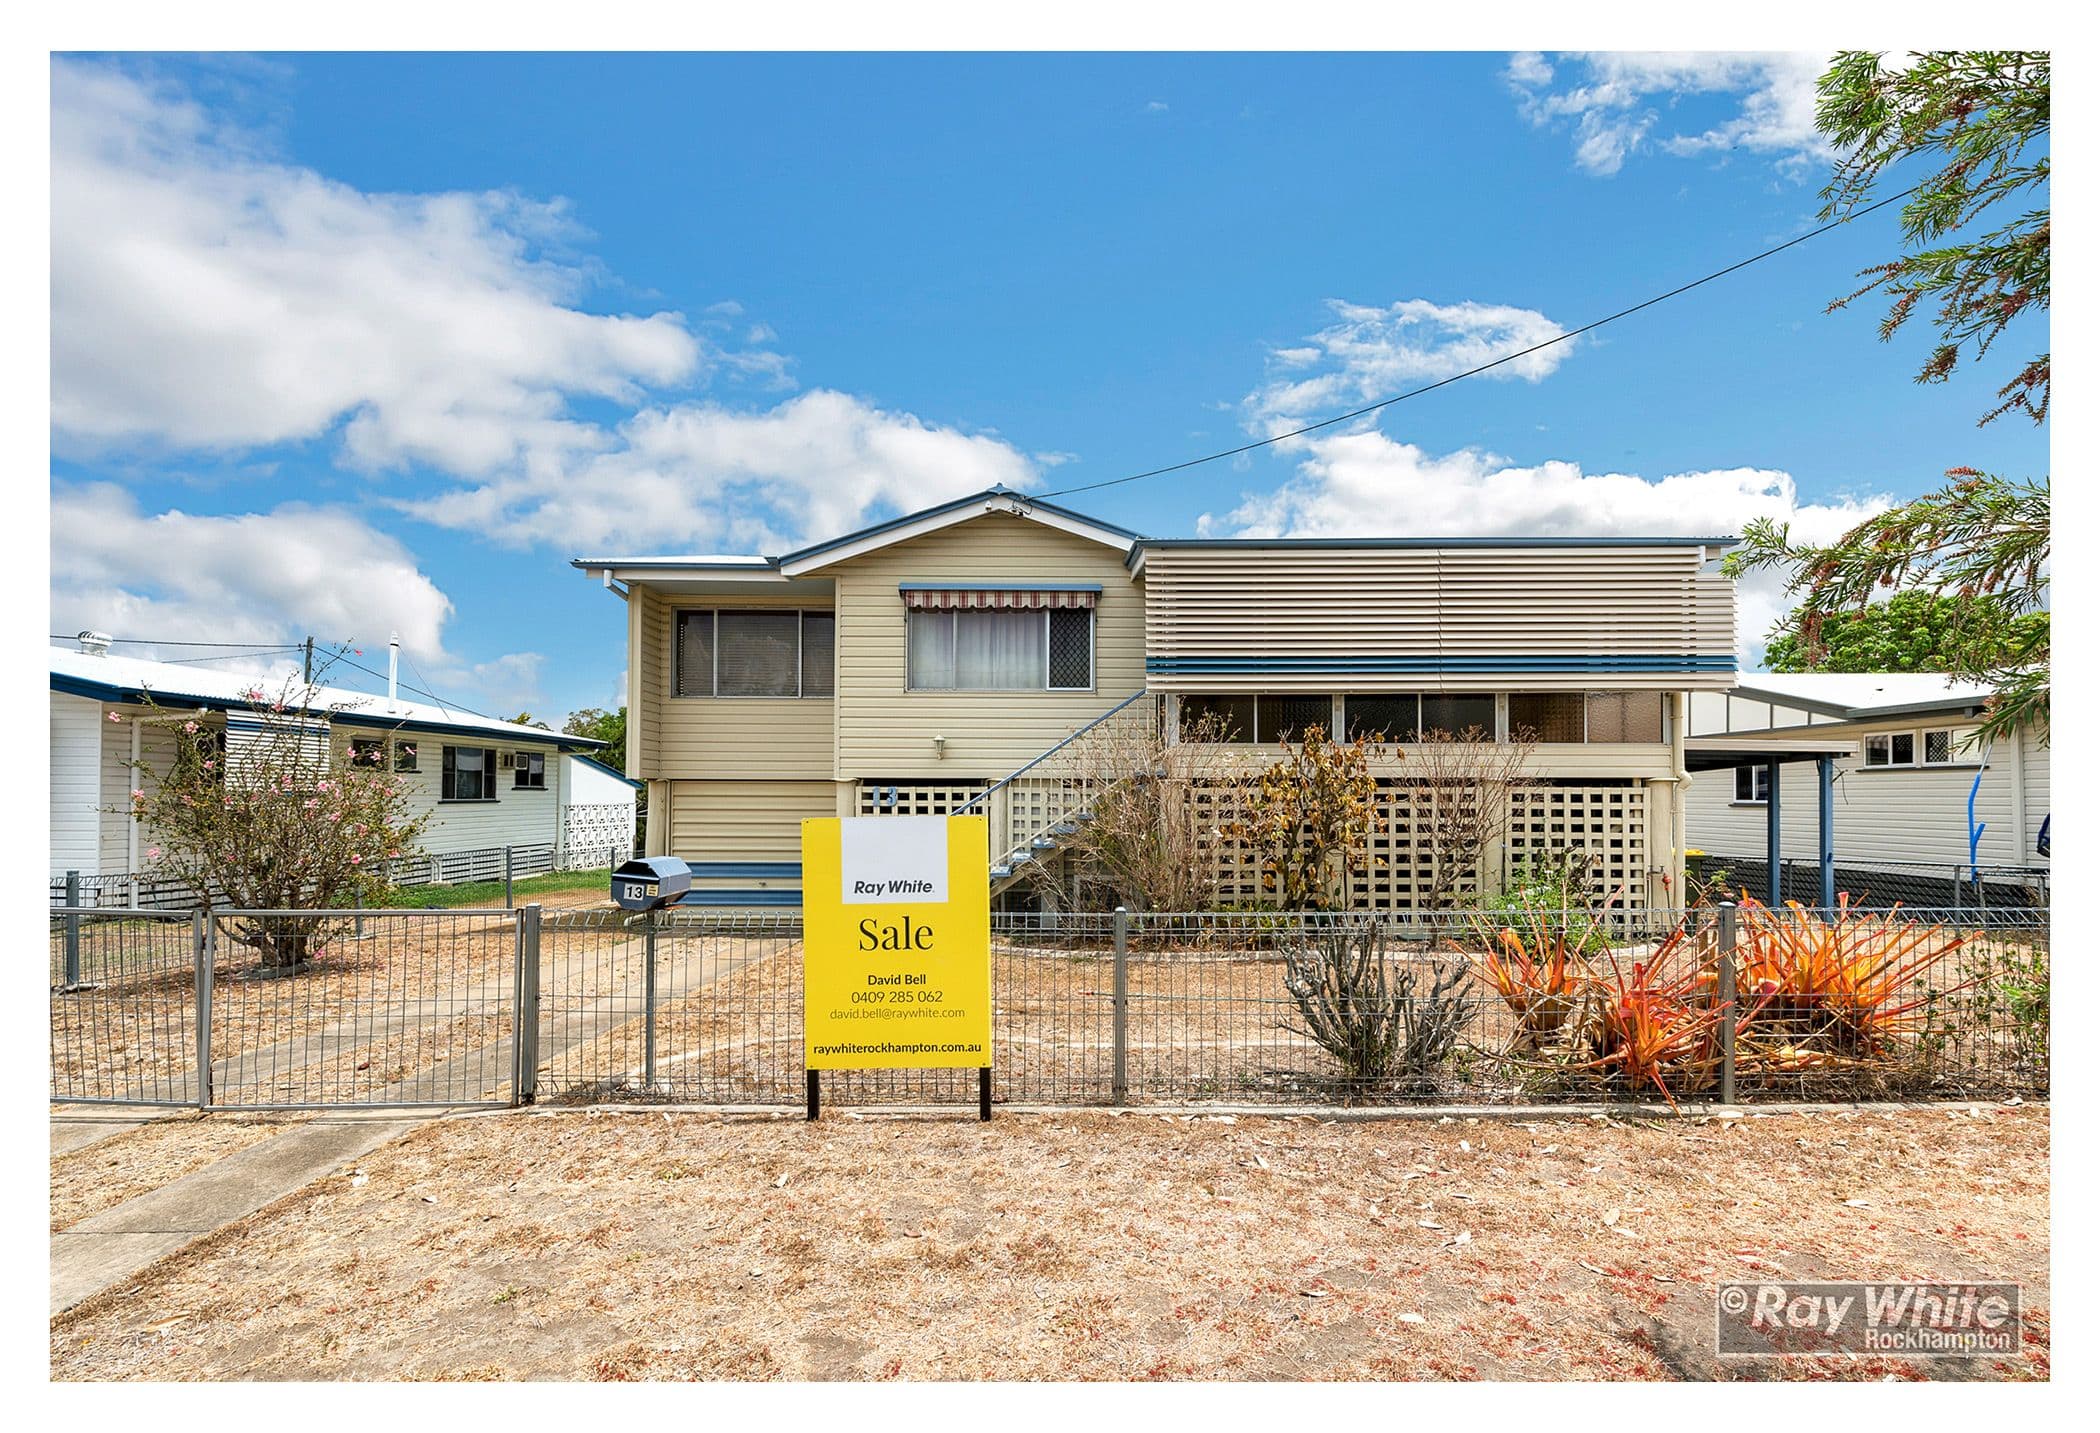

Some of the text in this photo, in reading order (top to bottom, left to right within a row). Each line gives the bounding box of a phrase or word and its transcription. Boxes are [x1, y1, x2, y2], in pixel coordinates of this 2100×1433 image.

[872, 785, 897, 807] 13
[626, 886, 643, 898] 13
[854, 880, 933, 896] Ray White
[859, 916, 934, 951] Sale
[867, 974, 926, 985] David Bell
[851, 990, 943, 1003] 0409 285 062
[829, 1006, 965, 1021] david.bell@raywhite.com
[813, 1041, 982, 1055] raywhiterockhampton.com.au
